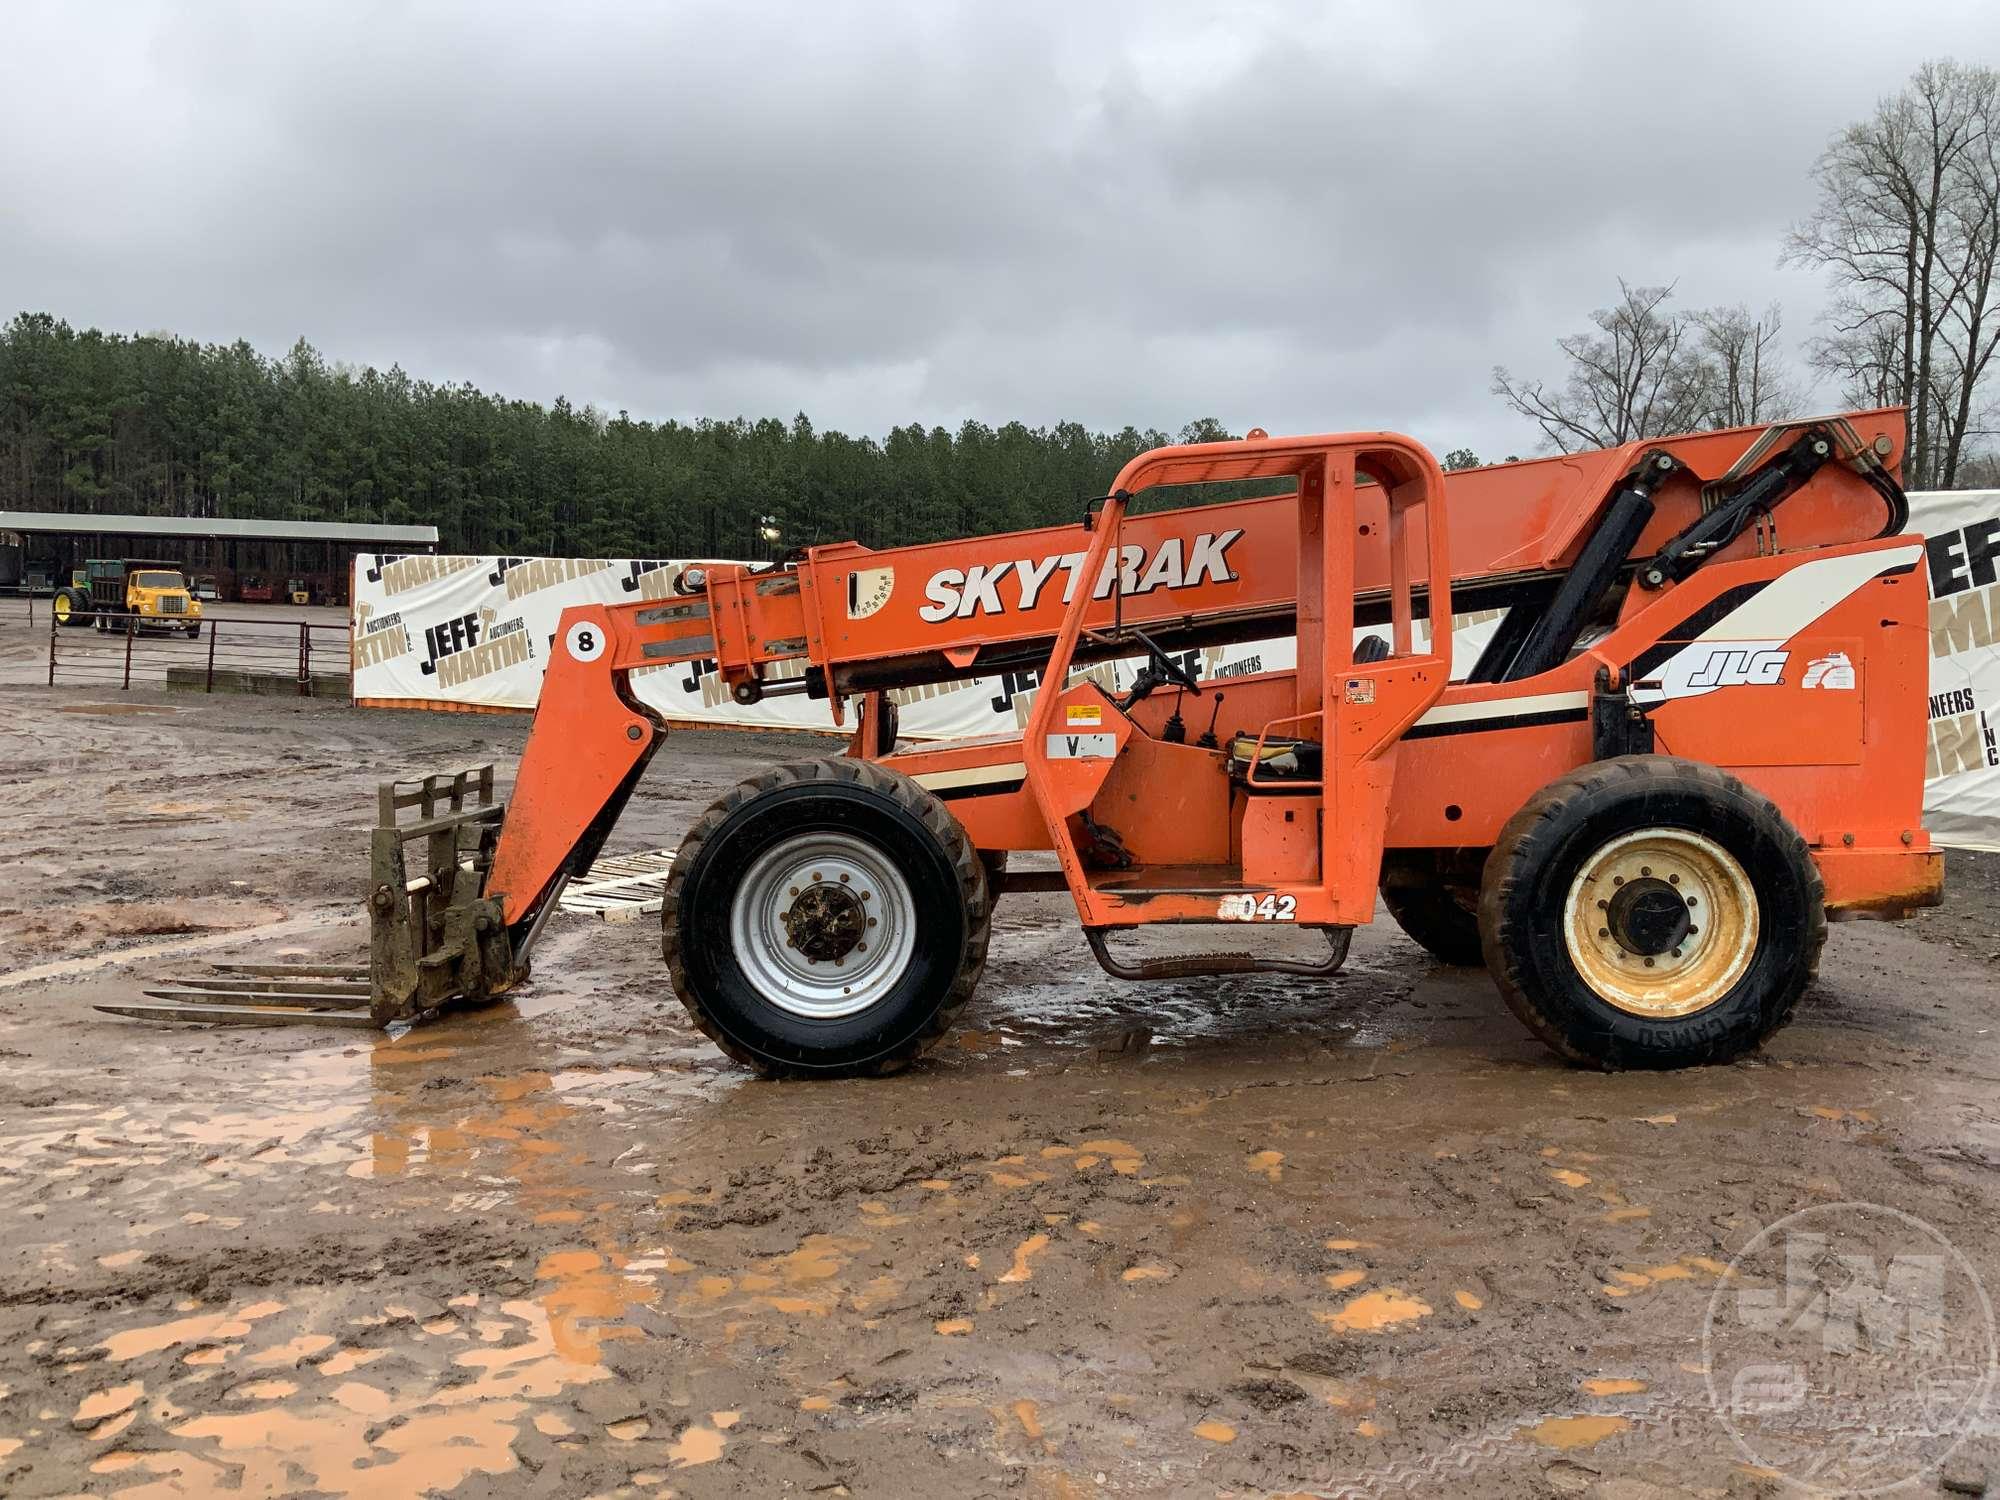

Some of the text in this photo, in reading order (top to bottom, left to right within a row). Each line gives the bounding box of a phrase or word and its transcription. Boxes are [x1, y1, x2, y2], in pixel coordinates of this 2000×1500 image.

[918, 529, 1244, 623] SKYTRAK
[366, 612, 402, 634] AUCTIONEERS
[489, 616, 525, 640] AUCTIONEERS
[420, 612, 482, 676] JEFF
[578, 631, 595, 652] 8
[435, 629, 529, 690] MARTIN
[1214, 654, 1262, 680] AUCTIONEERS
[1687, 650, 1791, 687] JLG
[1217, 893, 1298, 921] 042
